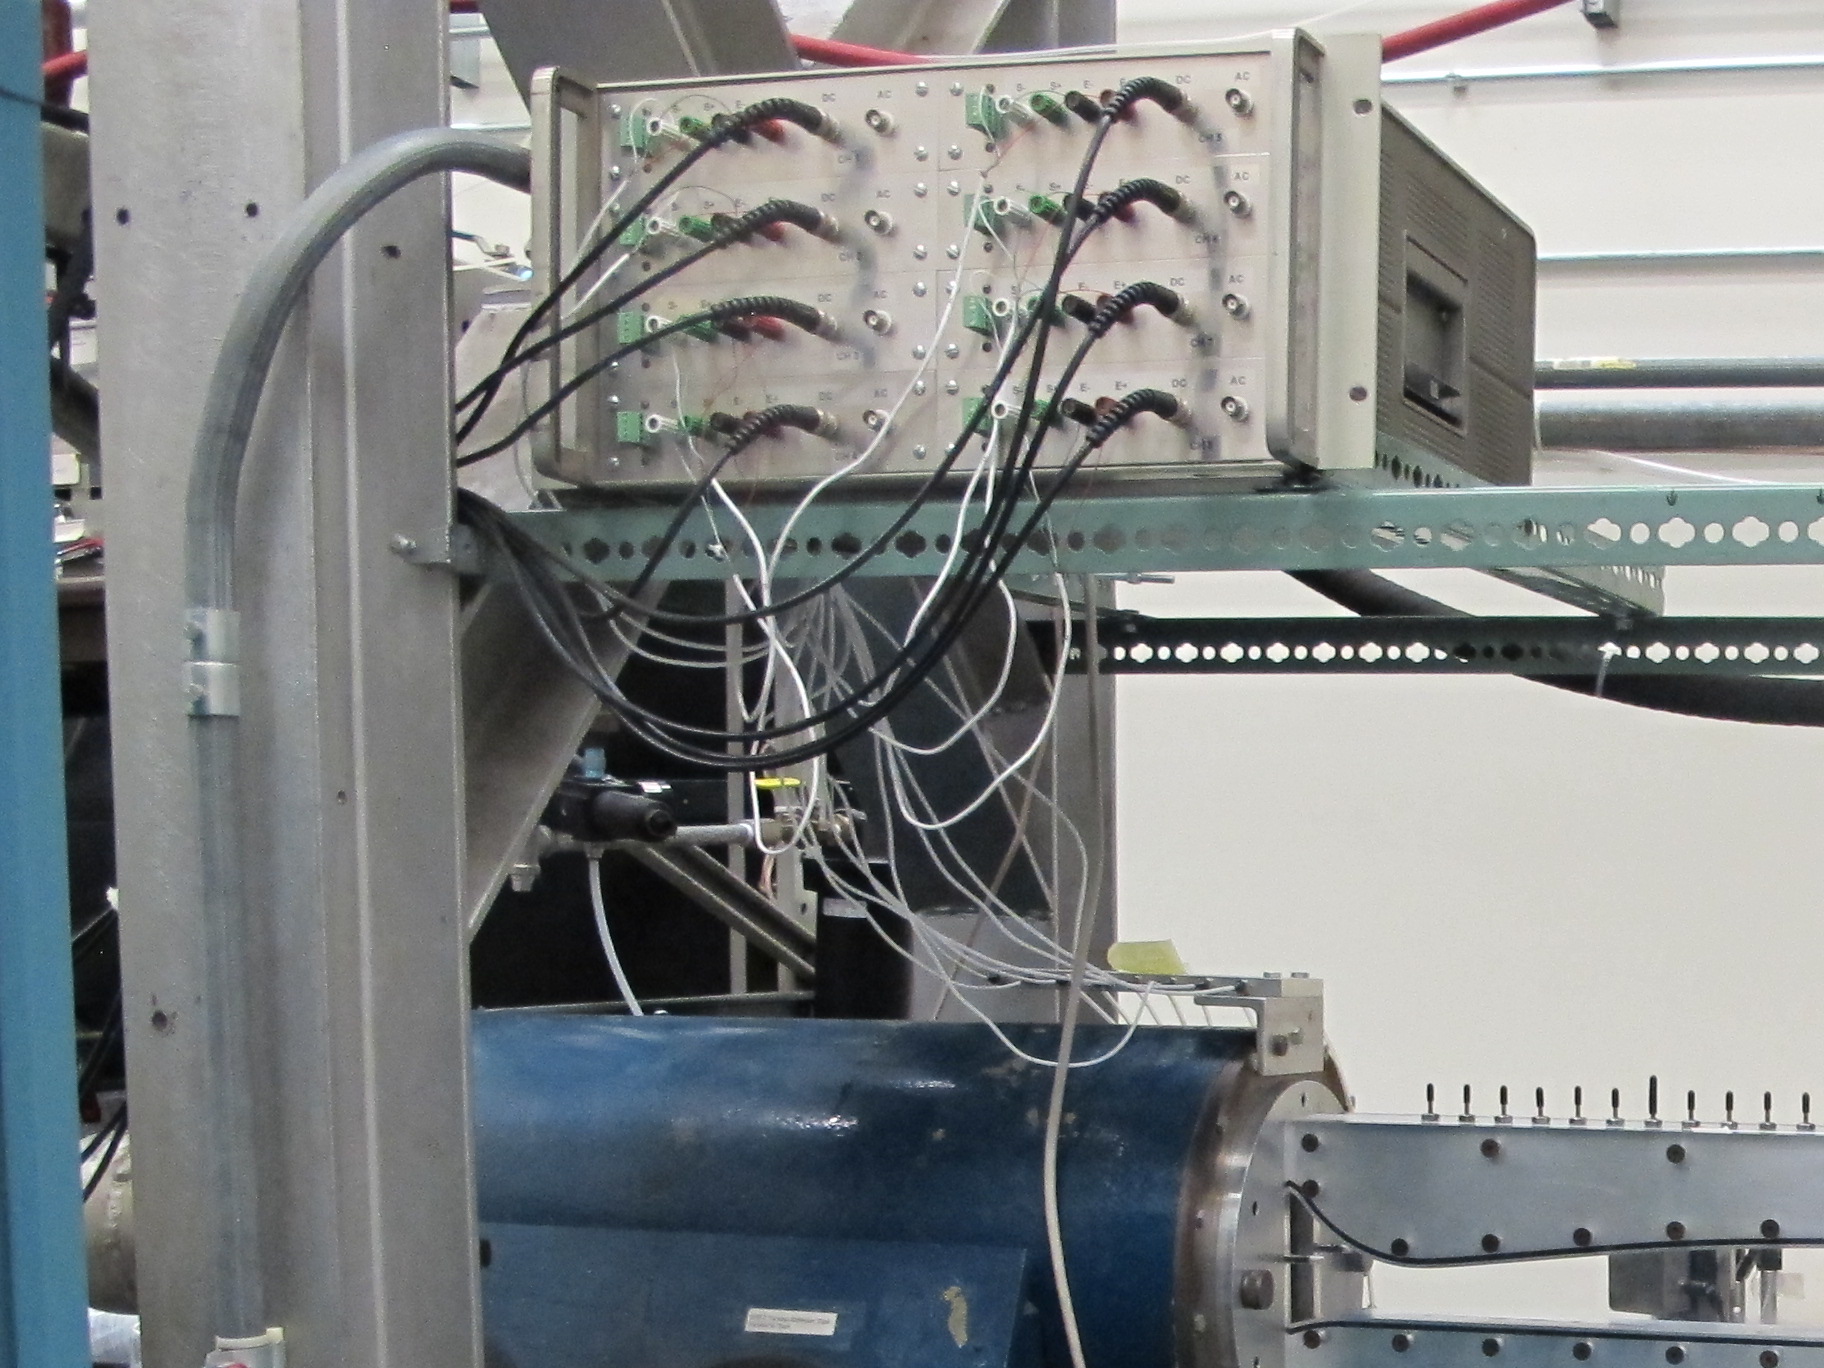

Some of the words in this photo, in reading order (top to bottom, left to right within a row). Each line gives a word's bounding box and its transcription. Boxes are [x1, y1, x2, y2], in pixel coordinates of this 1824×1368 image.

[1176, 75, 1191, 84] DC
[1234, 72, 1250, 81] AC
[877, 90, 892, 99] AC
[1176, 174, 1191, 184] DC
[1234, 171, 1249, 181] AC
[876, 190, 891, 199] AC
[1170, 277, 1185, 287] DC
[1229, 274, 1244, 283] AC
[873, 290, 888, 299] AC
[1172, 379, 1187, 388] DC
[1230, 375, 1246, 385] AC
